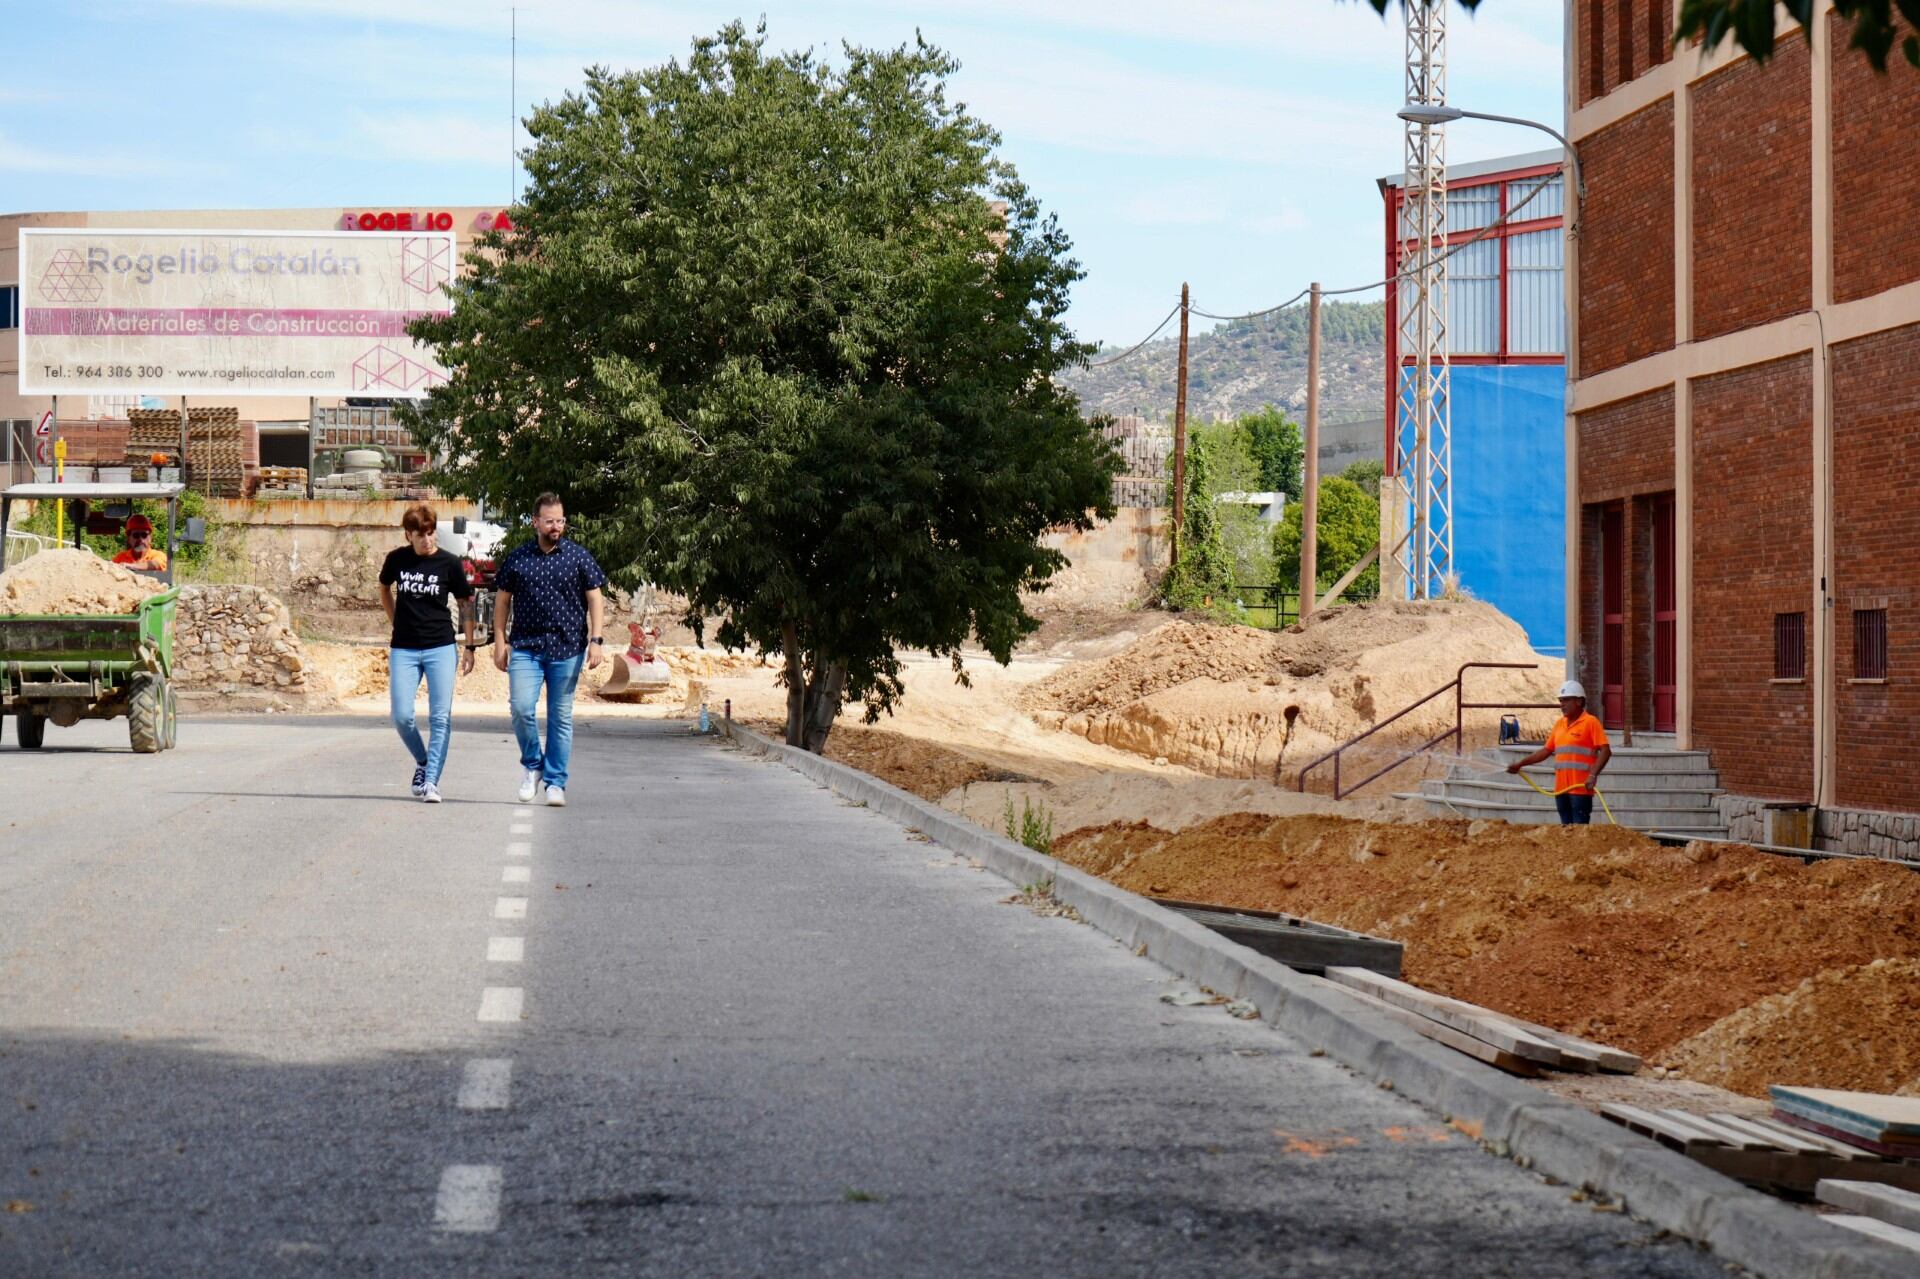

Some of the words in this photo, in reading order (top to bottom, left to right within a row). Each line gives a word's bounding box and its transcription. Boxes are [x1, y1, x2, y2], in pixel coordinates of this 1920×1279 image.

[342, 212, 453, 231] ROGELIO
[474, 211, 515, 231] CA
[87, 247, 220, 285] Rogelio
[230, 247, 360, 275] Catalán
[97, 311, 206, 332] Materiales
[214, 311, 240, 332] de
[247, 312, 380, 333] Construcción
[44, 365, 71, 378] Tel.:
[76, 366, 103, 378] 964
[107, 366, 132, 378] 386
[138, 366, 163, 378] 300
[177, 365, 335, 382] www.rogeliocatalan.com
[398, 580, 440, 596] URGENTE
